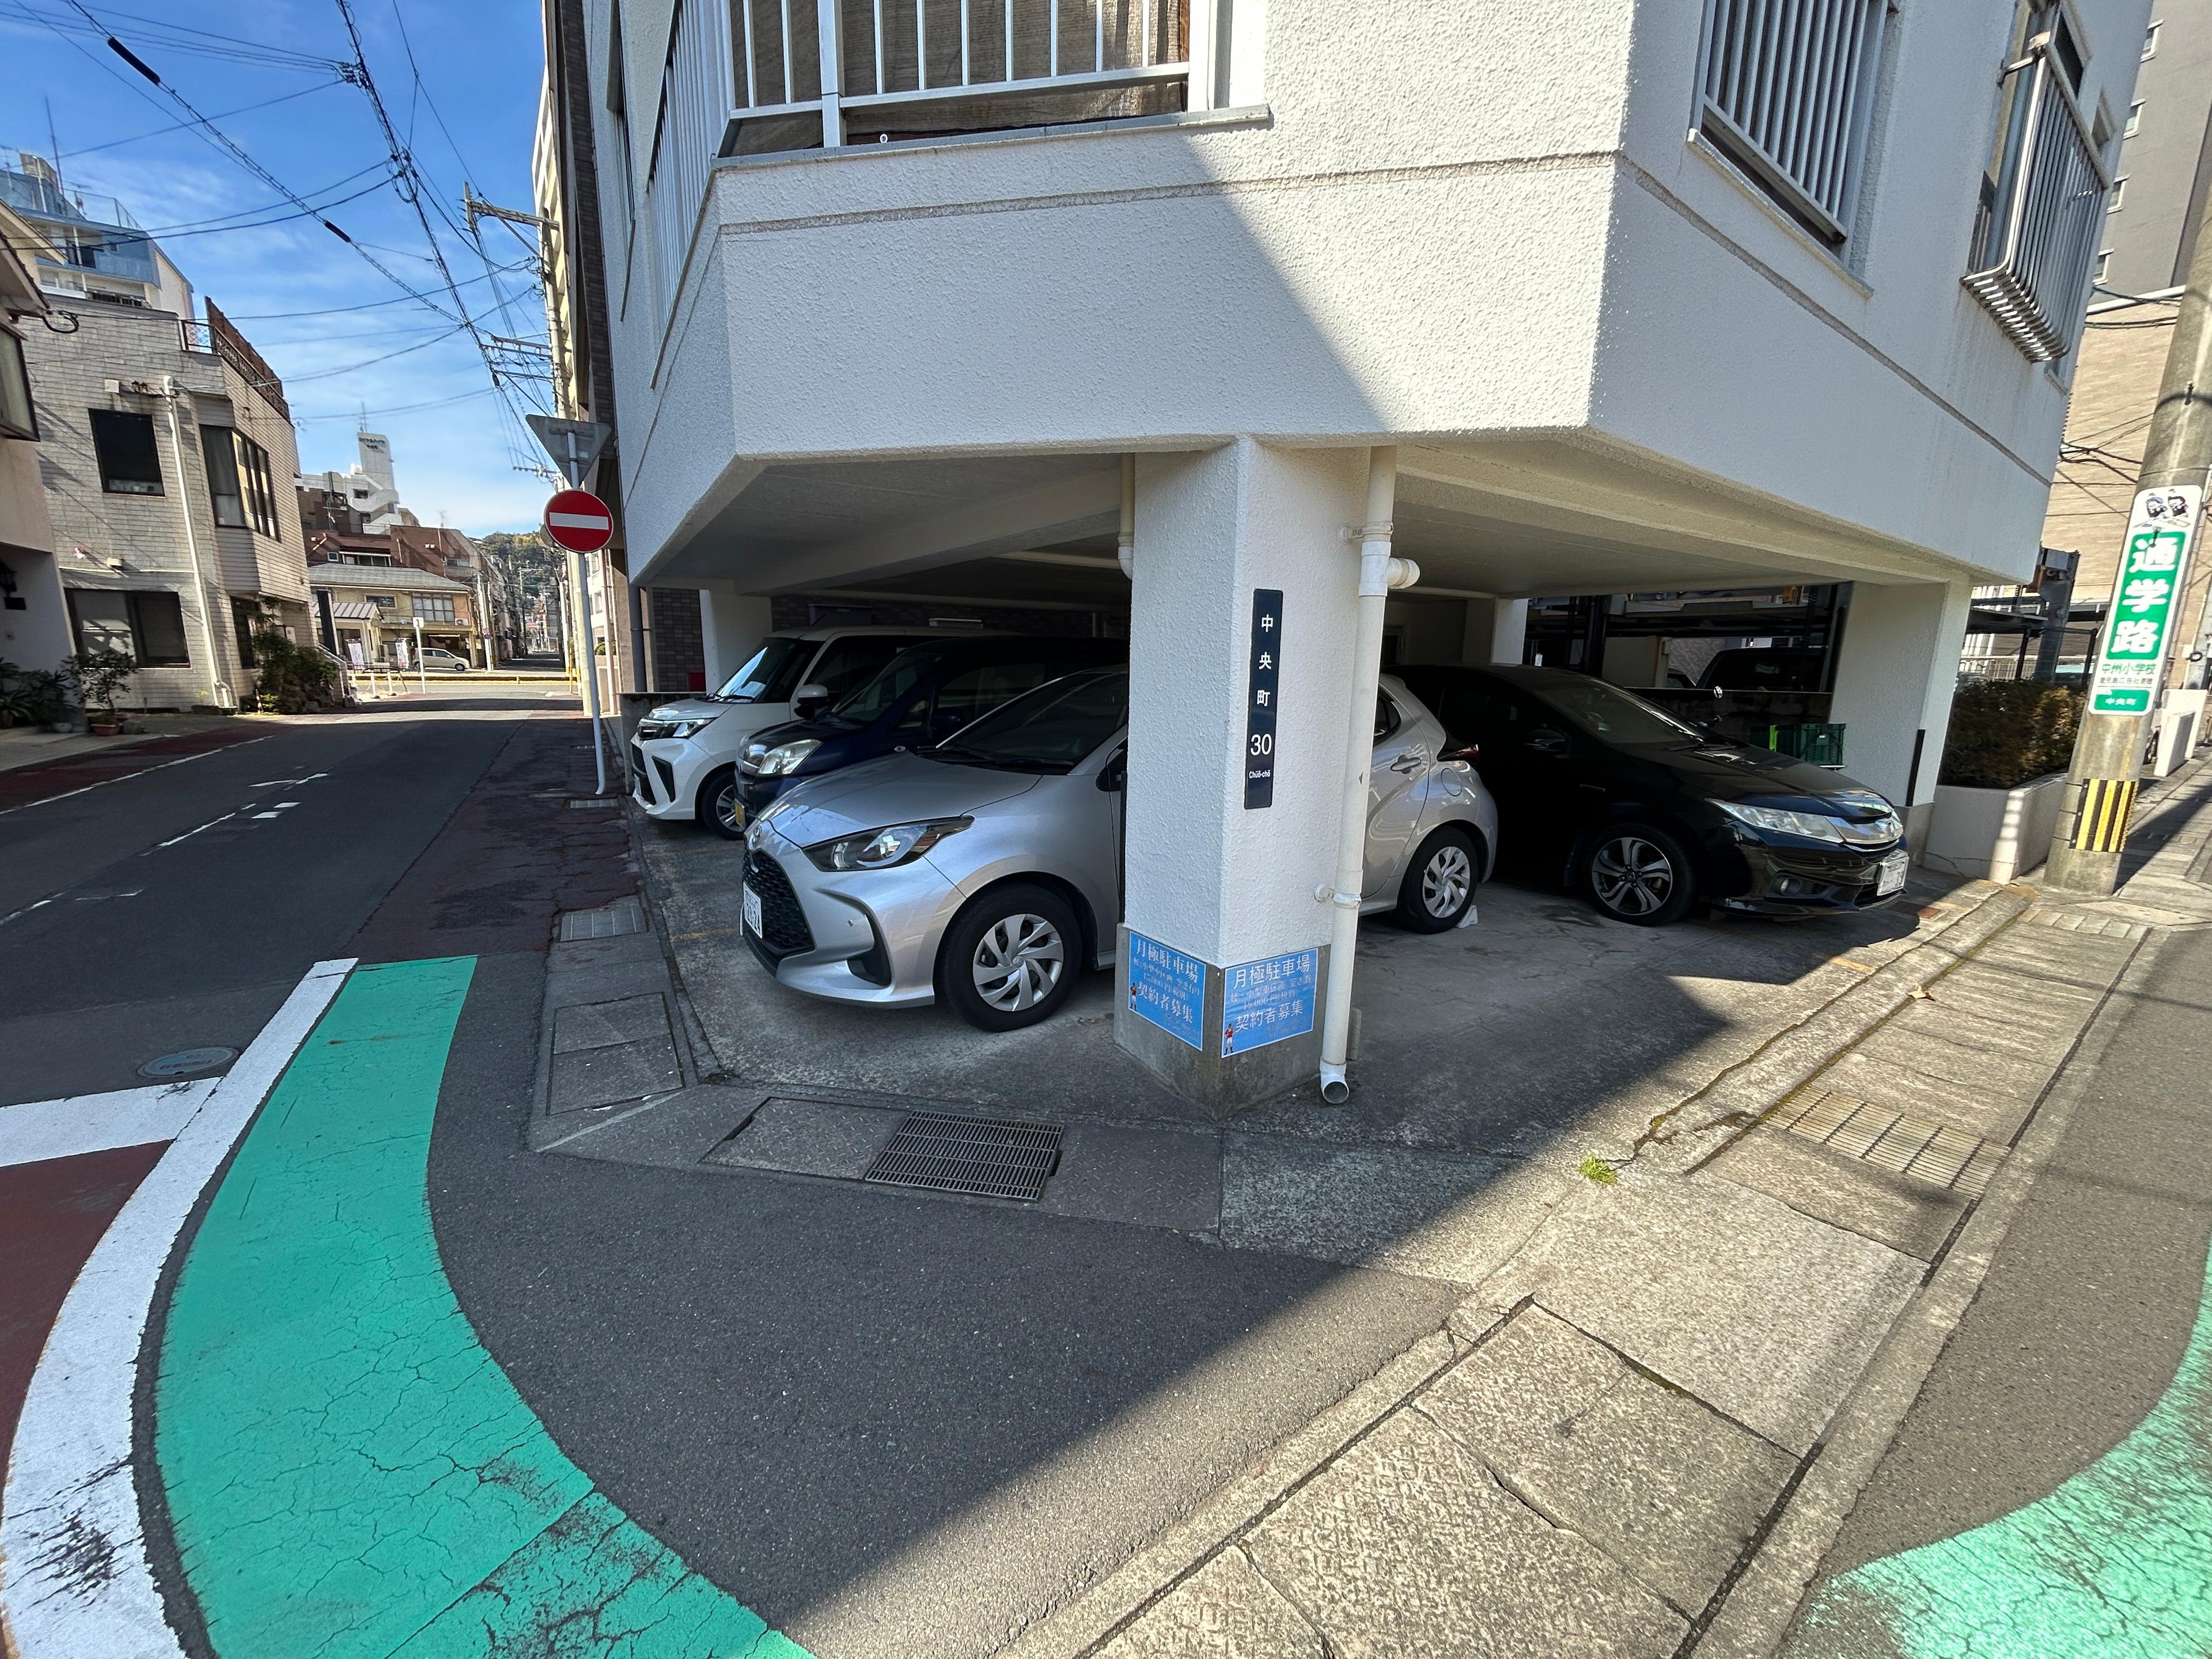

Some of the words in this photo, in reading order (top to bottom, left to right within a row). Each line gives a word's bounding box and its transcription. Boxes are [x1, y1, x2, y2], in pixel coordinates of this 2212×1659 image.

[2111, 536, 2178, 654] 通学路
[1256, 613, 1274, 707] 中央町
[2102, 662, 2157, 675] 中州小学校
[1250, 733, 1272, 756] 30
[1136, 939, 1198, 984] 月極駐車場
[1234, 954, 1310, 990] 月極駐車場
[1138, 981, 1193, 1024] 契約者募集
[1235, 999, 1304, 1033] 契約者募集
